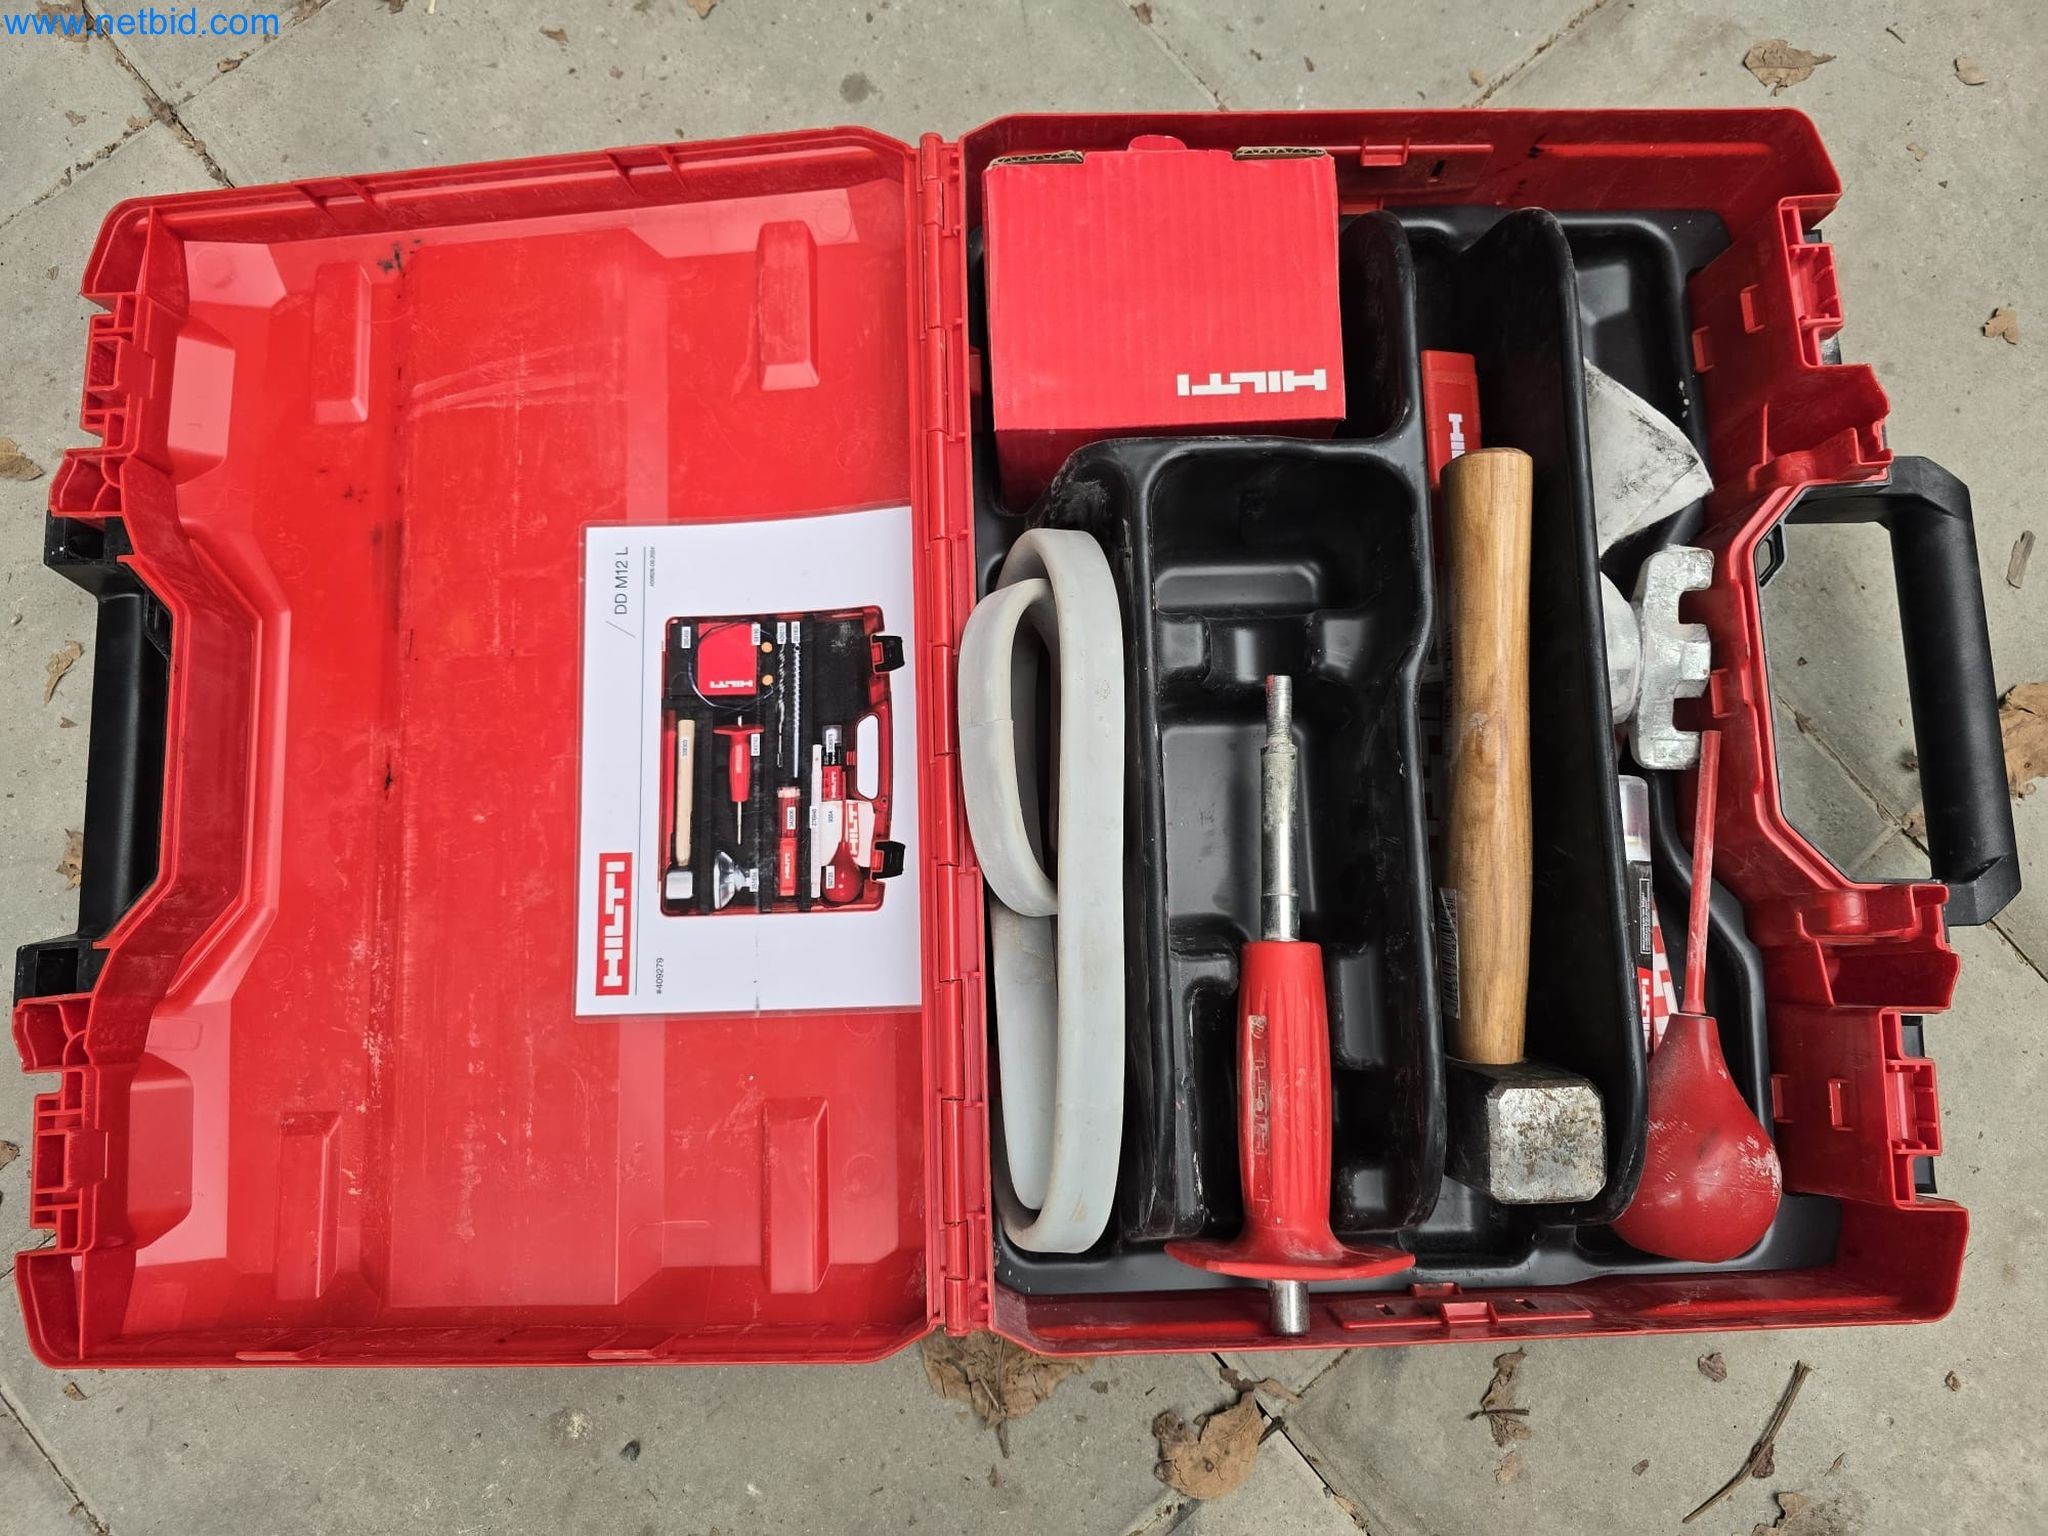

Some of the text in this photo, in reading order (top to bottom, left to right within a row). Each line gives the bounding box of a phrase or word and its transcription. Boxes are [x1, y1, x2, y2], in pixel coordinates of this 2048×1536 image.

[1177, 369, 1327, 396] HILTI
[614, 546, 629, 615] DD M12 L
[709, 680, 753, 689] HILTI
[603, 861, 625, 987] HILTI
[655, 957, 664, 995] #409279
[1254, 1059, 1268, 1155] HILTI
